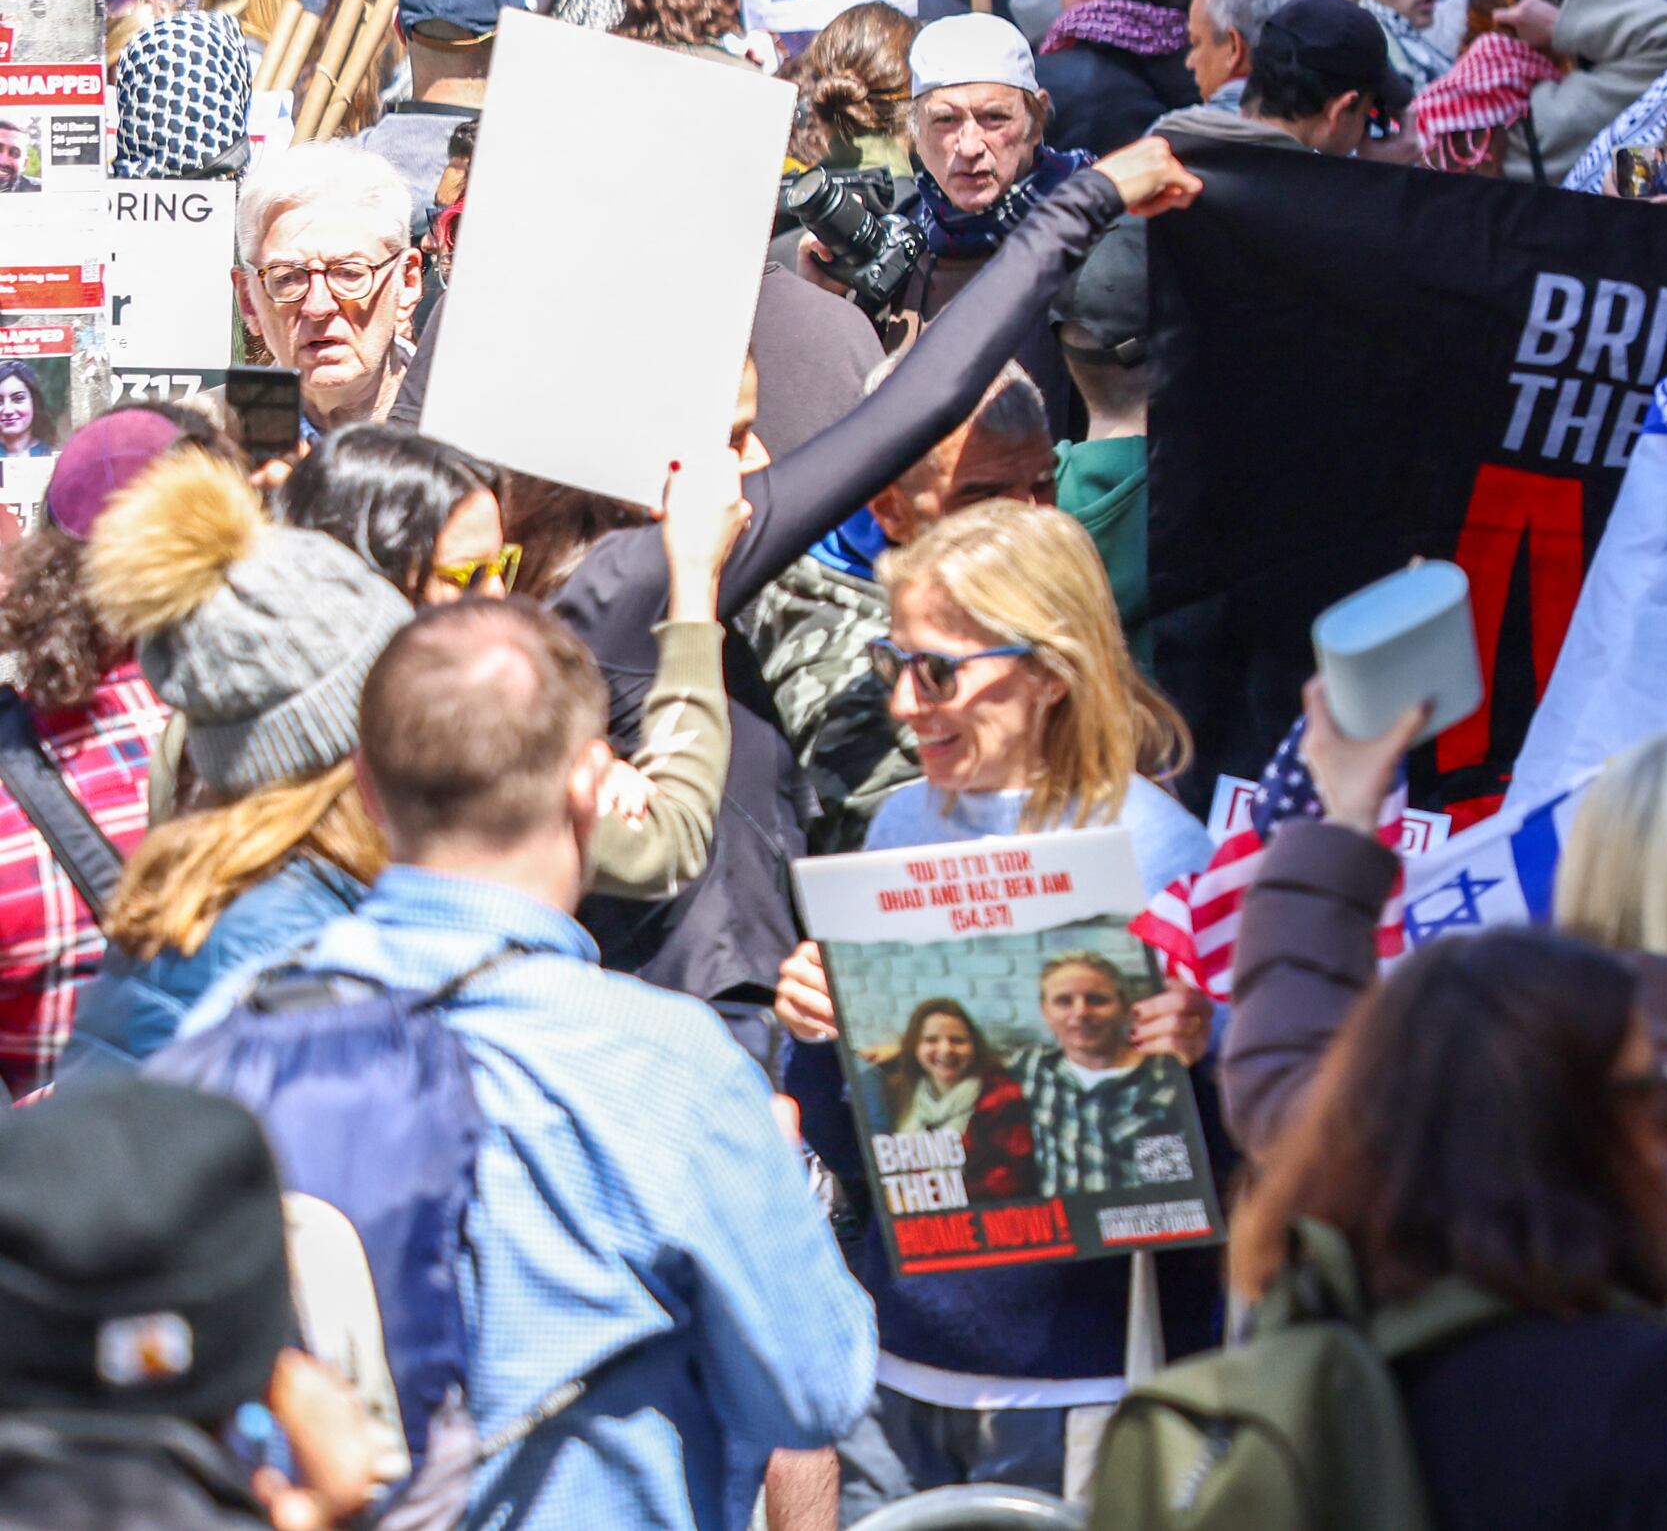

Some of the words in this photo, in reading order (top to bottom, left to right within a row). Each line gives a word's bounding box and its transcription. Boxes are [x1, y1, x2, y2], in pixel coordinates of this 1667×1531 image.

[108, 192, 213, 222] RING
[1502, 372, 1654, 468] THE
[929, 883, 963, 907] AND
[1004, 876, 1036, 898] BEN
[871, 1127, 967, 1175] BRING
[880, 1169, 969, 1214] THEM
[893, 1211, 981, 1257] HOME
[981, 1196, 1073, 1247] NOW!
